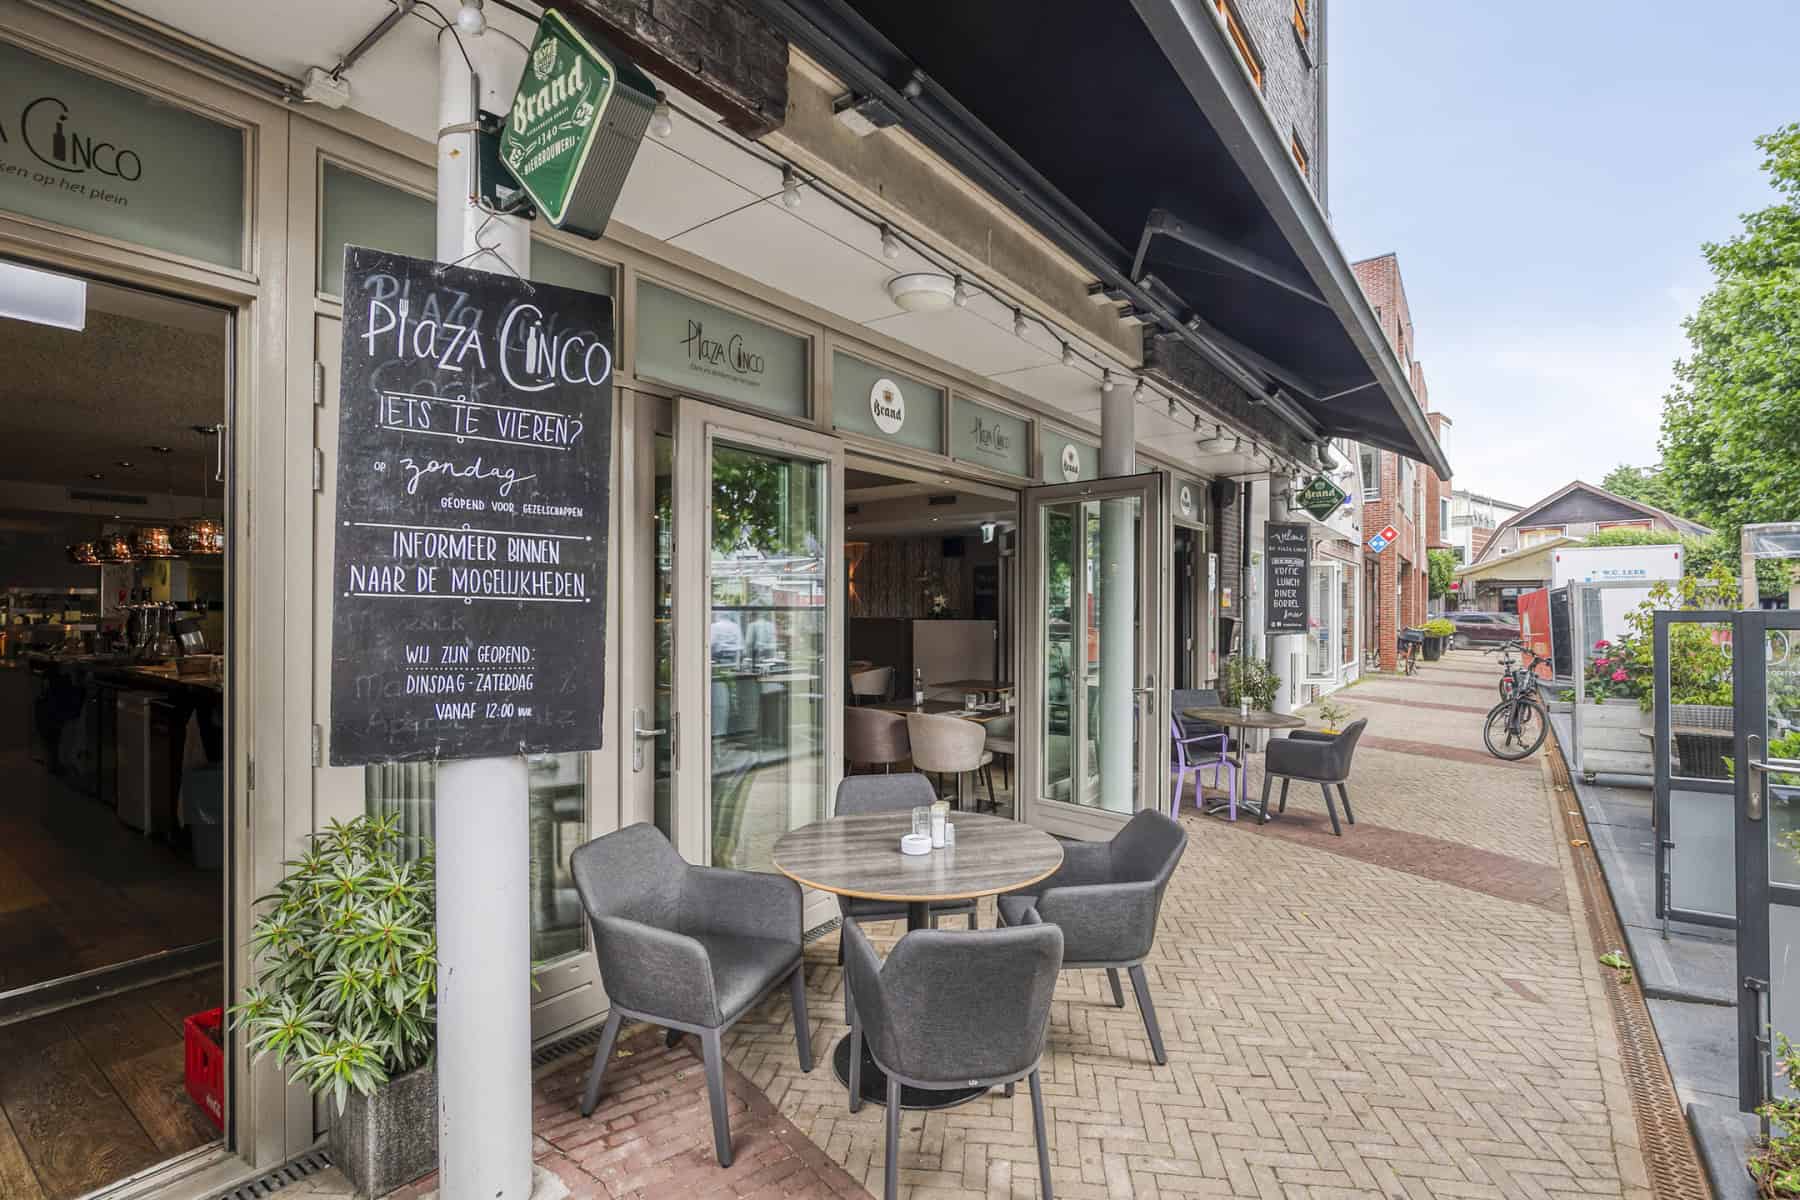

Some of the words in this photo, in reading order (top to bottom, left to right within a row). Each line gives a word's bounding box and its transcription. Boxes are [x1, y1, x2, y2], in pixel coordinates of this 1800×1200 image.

[513, 55, 584, 135] Brand
[537, 125, 558, 146] 1340
[524, 135, 576, 176] BIERBROUWERIJ
[33, 172, 55, 186] op
[59, 177, 86, 194] het
[89, 188, 128, 207] plein
[379, 396, 432, 429] IETS
[450, 403, 481, 434] TE
[497, 409, 584, 445] VIEREN?
[874, 399, 902, 421] Brand
[373, 461, 387, 473] OP
[400, 457, 537, 496] zondag
[1304, 487, 1336, 500] Brand
[441, 497, 485, 512] GEOPEND
[491, 501, 515, 513] VOOR
[523, 503, 584, 518] GEZELSCHAPPEN
[392, 531, 498, 562] INFORMEER
[507, 537, 561, 565] BINNEN
[350, 565, 407, 593] NAAR
[417, 566, 438, 593] DE
[452, 567, 586, 598] MOGELIJKHEDEN
[1274, 589, 1297, 599] DINER
[406, 645, 430, 664] WIJ
[440, 645, 469, 664] ZIJN
[477, 645, 536, 663] GEOPEND:
[435, 702, 477, 722] VANAF
[486, 702, 515, 720] 12:00
